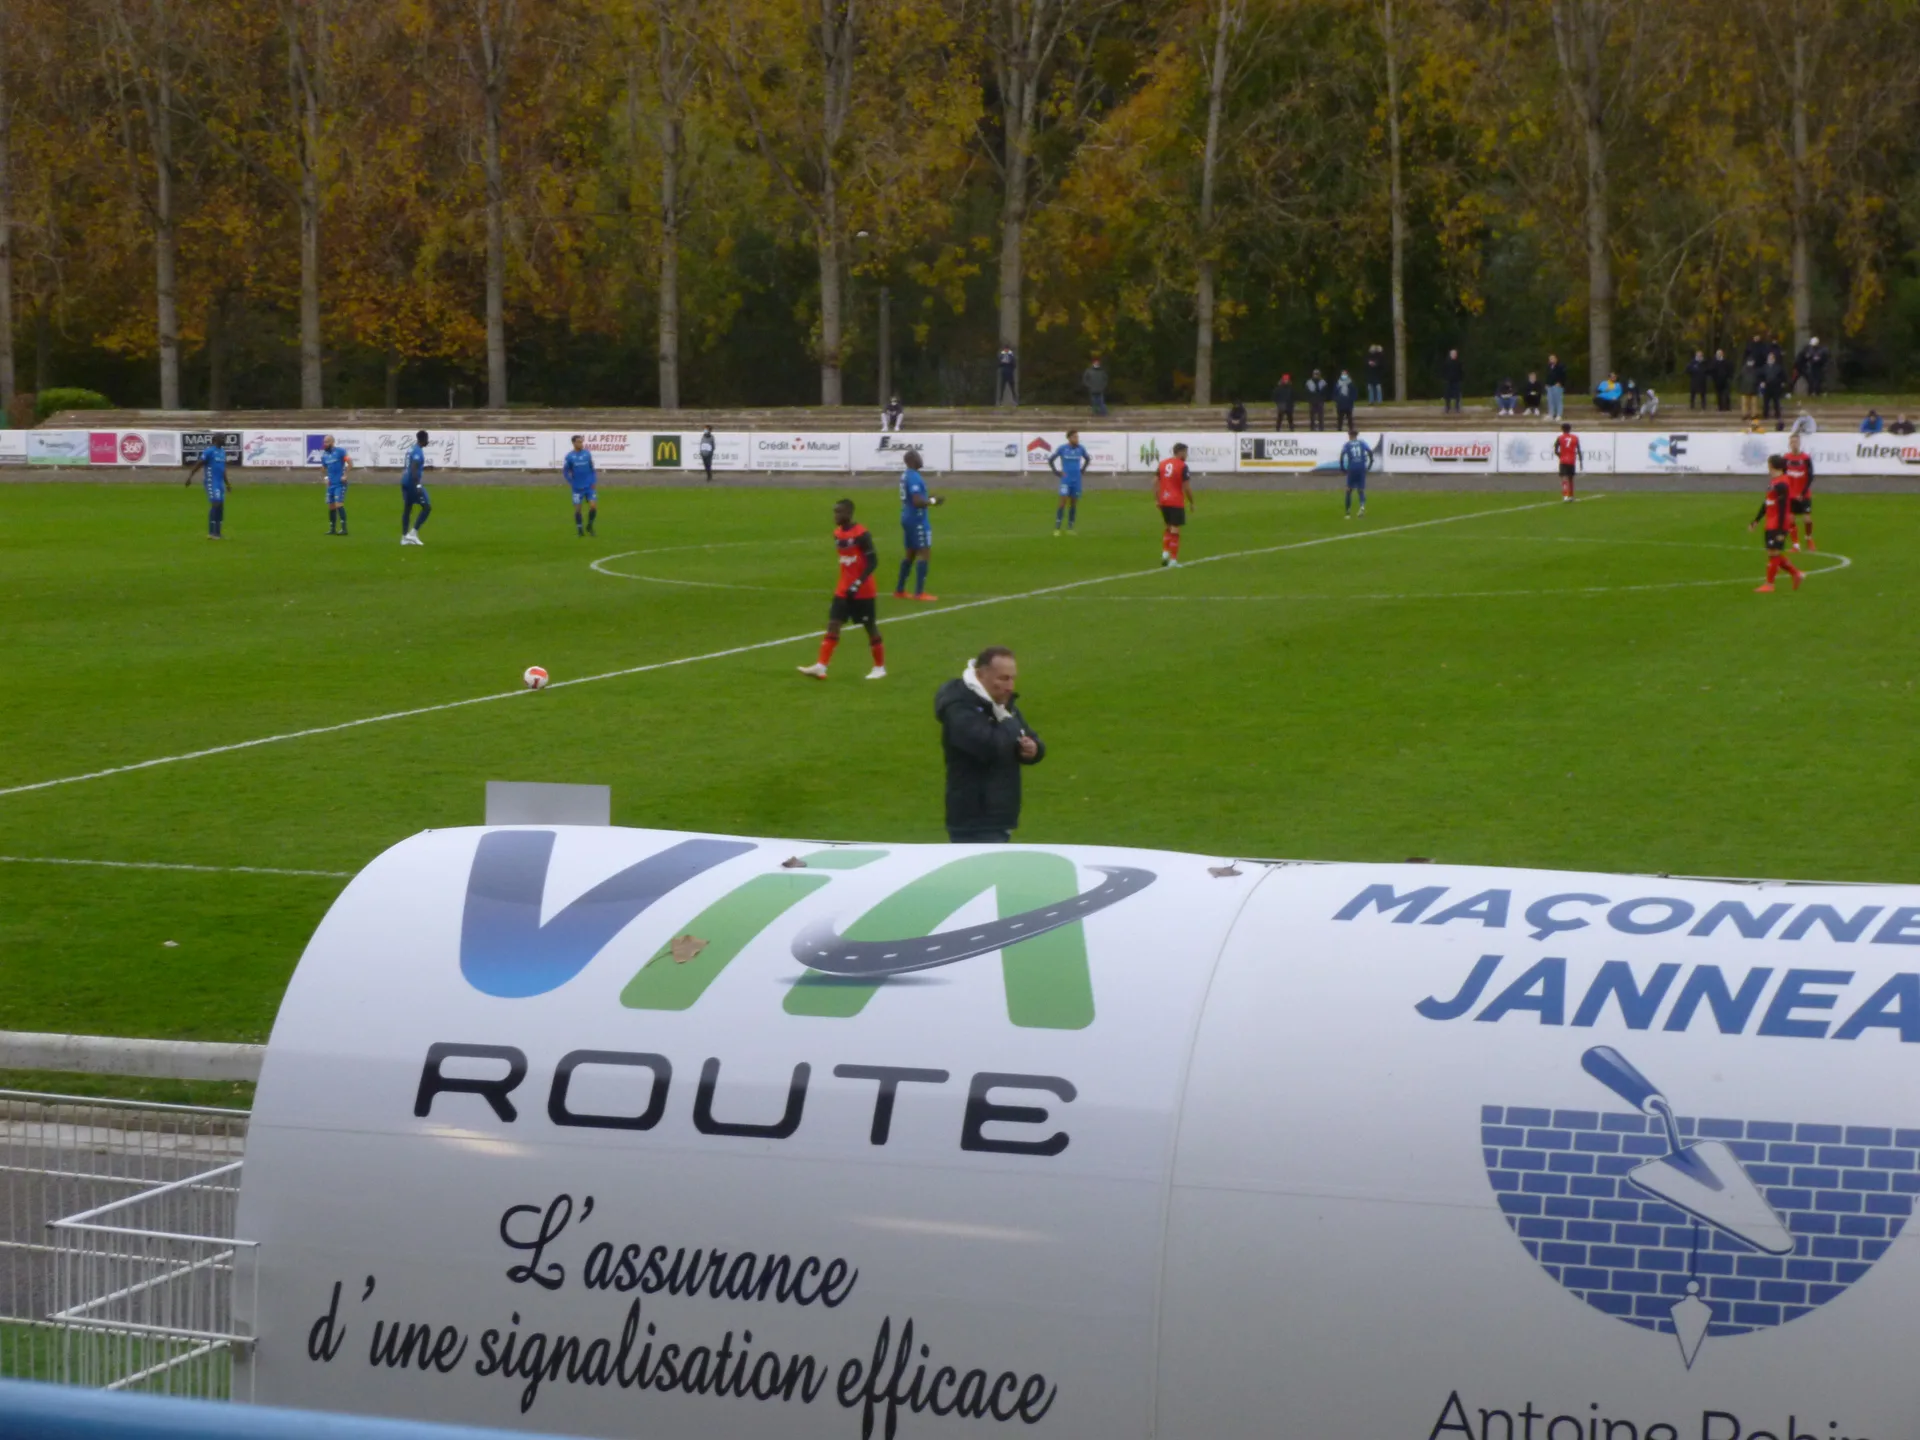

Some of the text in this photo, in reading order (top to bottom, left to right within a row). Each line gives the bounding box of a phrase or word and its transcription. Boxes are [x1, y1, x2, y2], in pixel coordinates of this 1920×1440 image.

[807, 441, 841, 451] Mutuel
[1266, 440, 1298, 448] INTER
[1266, 448, 1318, 457] LOCATION
[1855, 443, 1920, 460] Interm
[1164, 463, 1174, 478] 9
[1414, 954, 1920, 1043] JANNEA
[414, 1042, 1078, 1157] ROUTE
[500, 1193, 859, 1308] L'assurance
[475, 1296, 828, 1414] signalisation
[836, 1315, 1057, 1440] efficace
